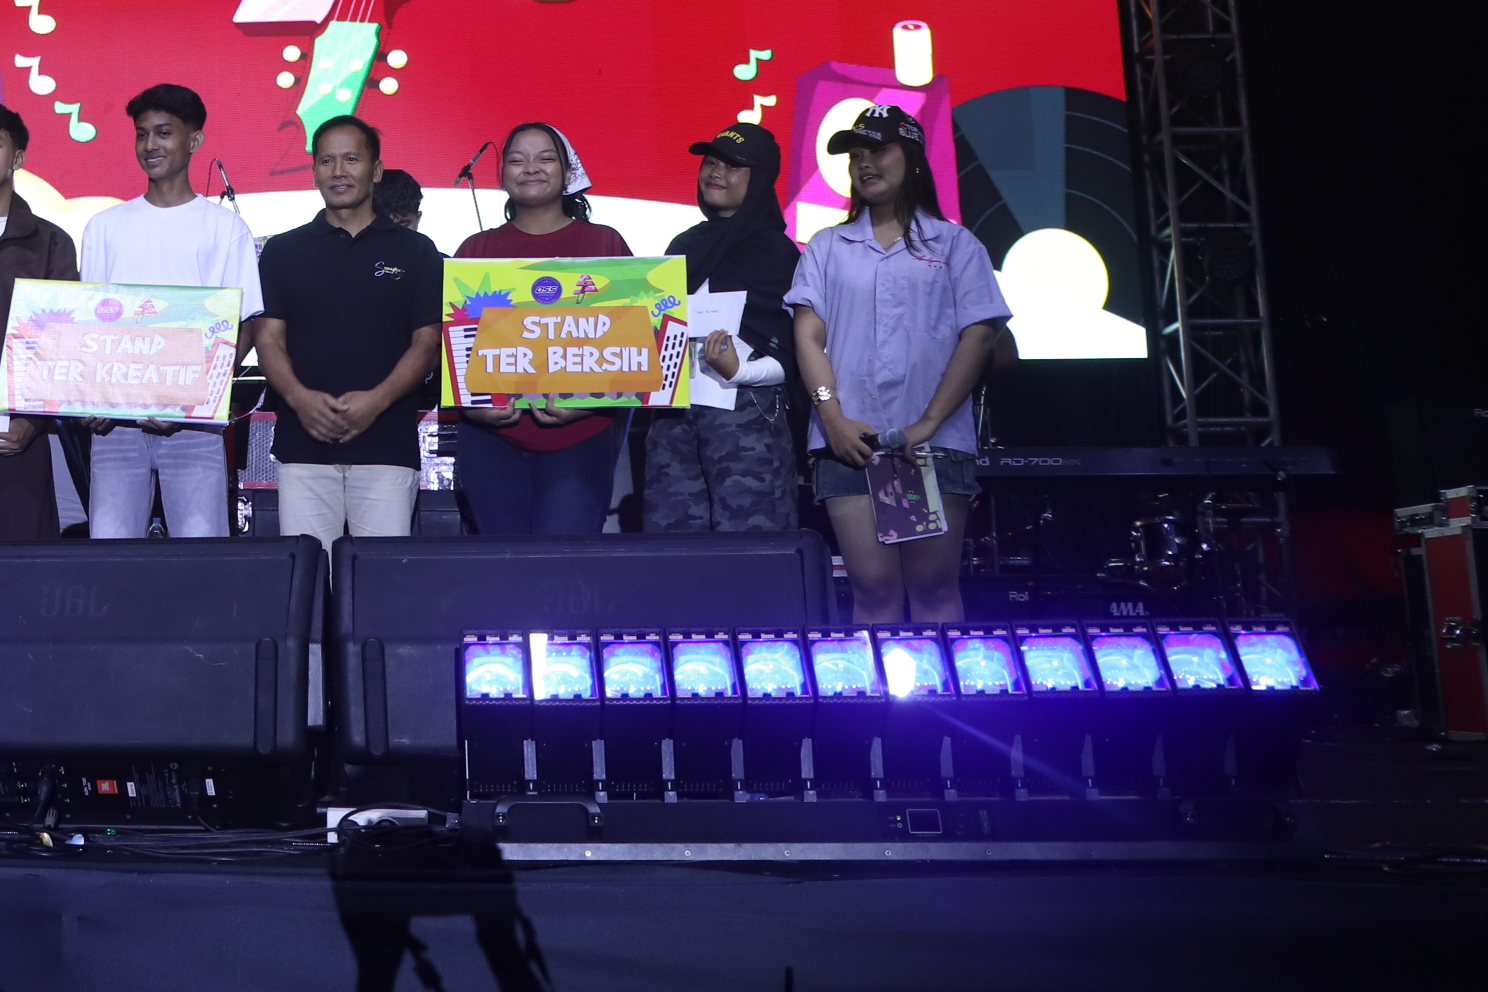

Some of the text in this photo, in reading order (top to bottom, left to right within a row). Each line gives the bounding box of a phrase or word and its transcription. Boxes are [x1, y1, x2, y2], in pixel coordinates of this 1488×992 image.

[521, 313, 612, 340] STAND
[80, 332, 167, 357] STAND
[477, 344, 650, 374] TER BERSIH
[36, 360, 203, 387] TER KREATIF
[1110, 602, 1146, 616] AMA
